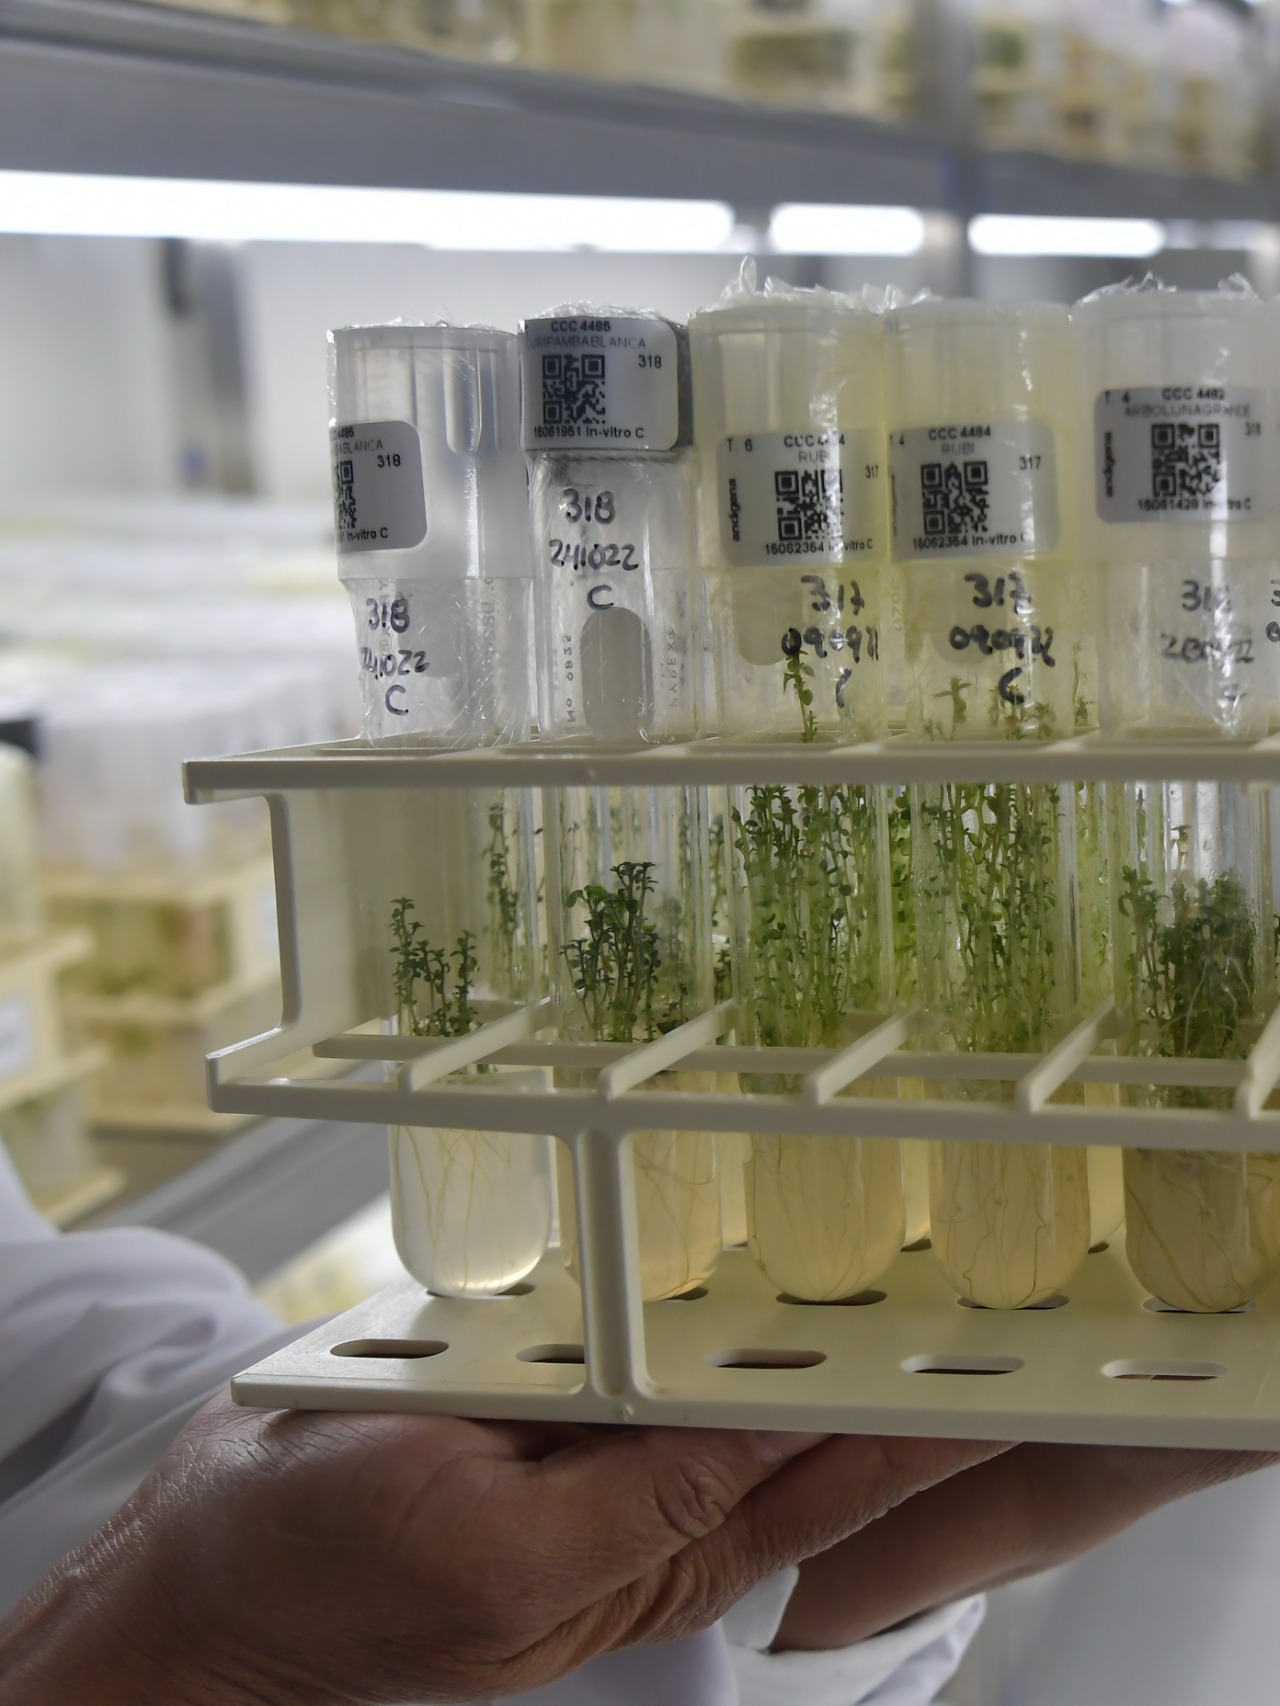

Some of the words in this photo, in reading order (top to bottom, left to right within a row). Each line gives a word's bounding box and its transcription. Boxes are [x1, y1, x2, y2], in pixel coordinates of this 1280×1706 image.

[551, 320, 577, 333] CCC
[637, 354, 662, 369] 318
[1161, 388, 1193, 400] CCC
[585, 425, 632, 439] In-vitro
[635, 427, 645, 439] C
[928, 428, 958, 441] CCC
[744, 439, 753, 452] 6
[784, 435, 815, 448] CCC
[377, 454, 401, 468] 318
[1019, 456, 1042, 471] 317
[866, 465, 879, 479] 317
[563, 488, 616, 525] 318
[728, 478, 741, 542] andigena
[380, 527, 389, 539] C
[971, 533, 1017, 547] In-vitro
[866, 538, 874, 549] C
[549, 539, 640, 571] 241022
[586, 584, 614, 611] C
[366, 598, 411, 634] 318
[998, 667, 1025, 705] C
[385, 684, 409, 716] C
